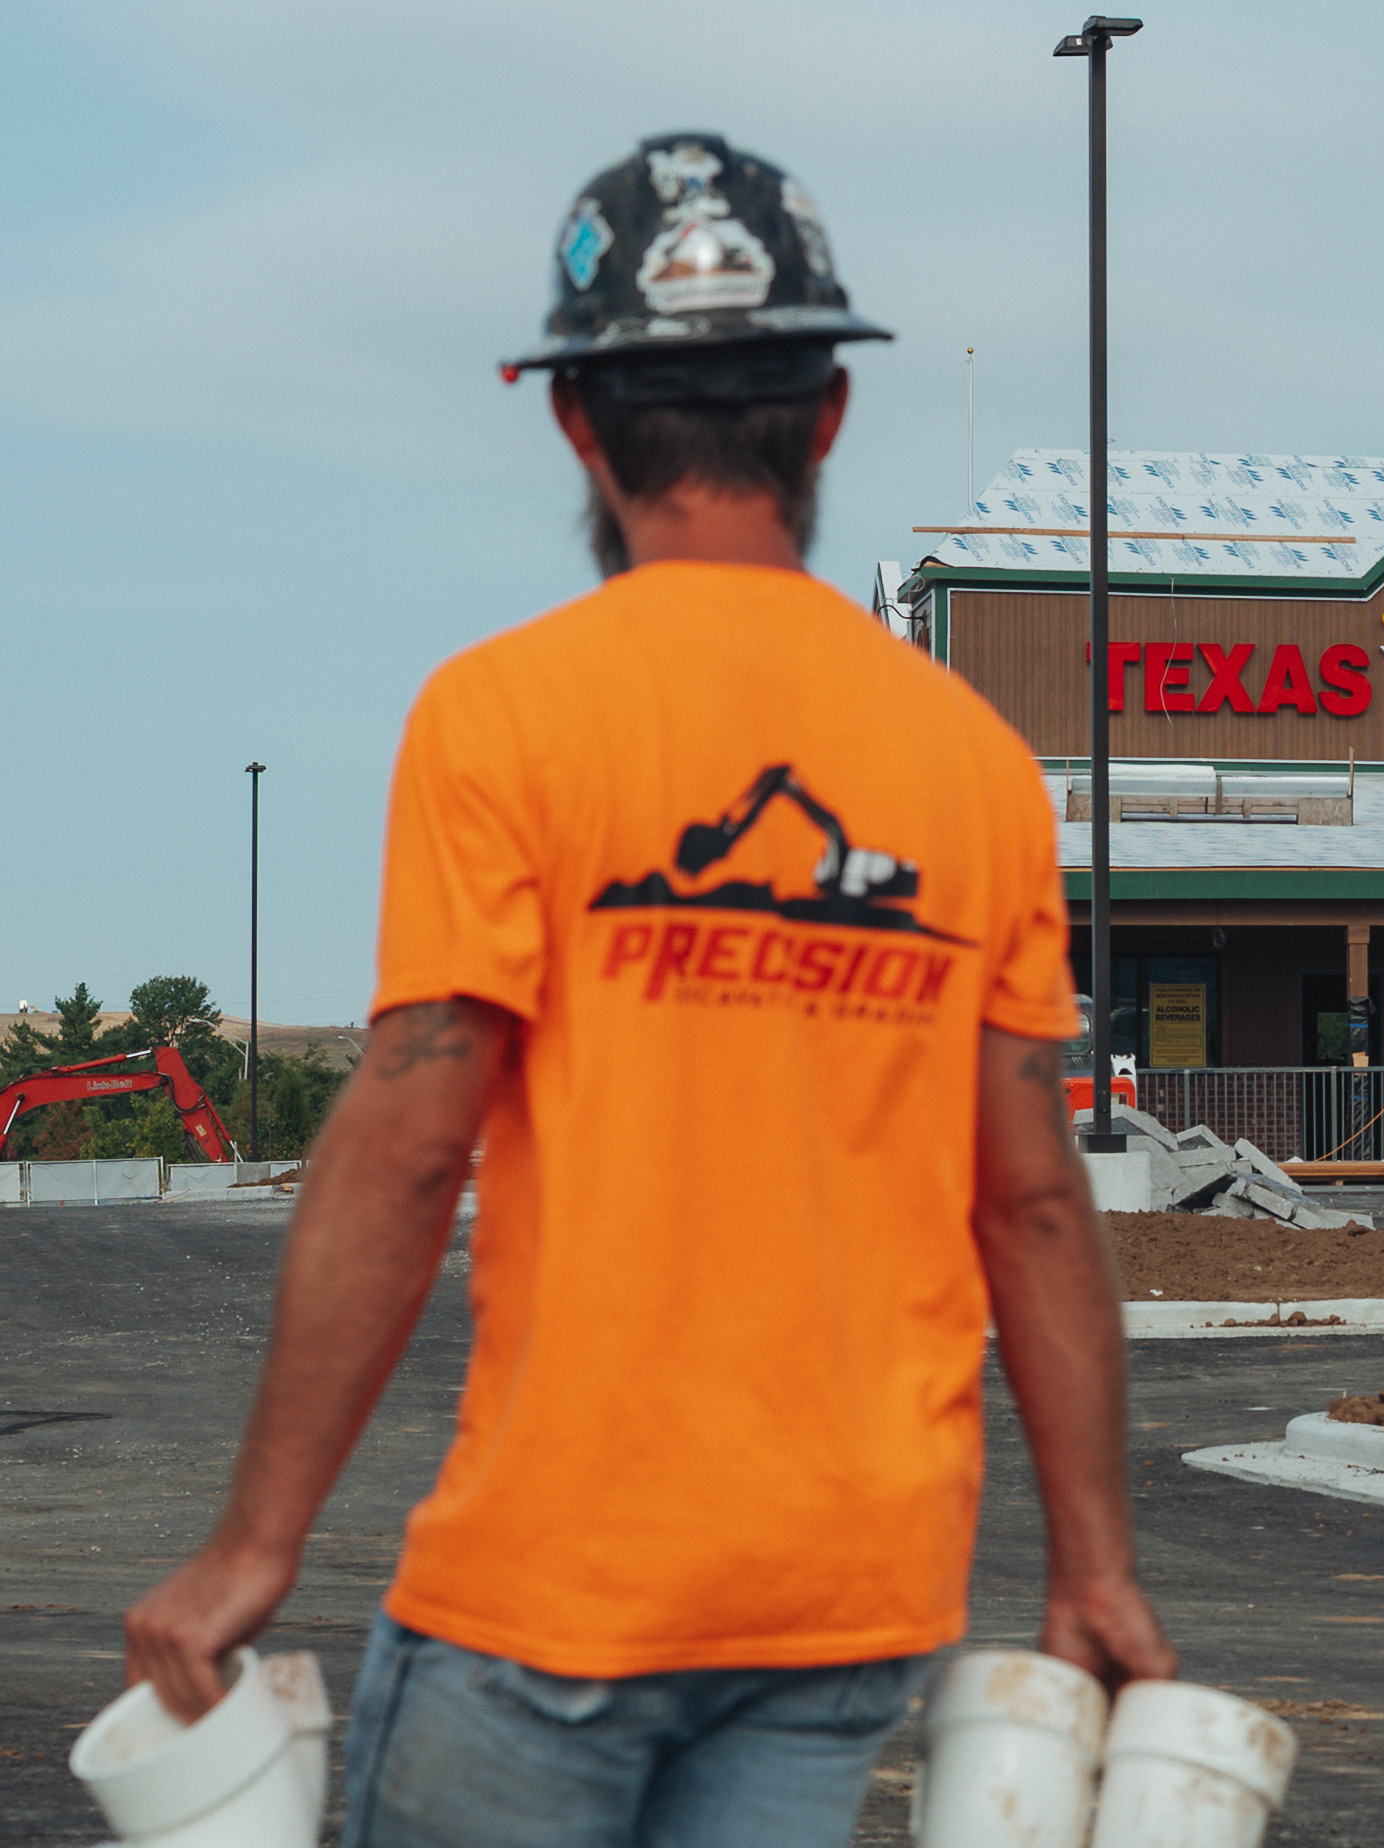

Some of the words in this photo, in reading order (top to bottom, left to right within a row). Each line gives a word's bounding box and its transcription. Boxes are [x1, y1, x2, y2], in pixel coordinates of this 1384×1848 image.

[1087, 641, 1373, 716] TEXAS
[603, 922, 954, 1003] PRECSION
[1156, 1005, 1200, 1013] ALCOHOLIC
